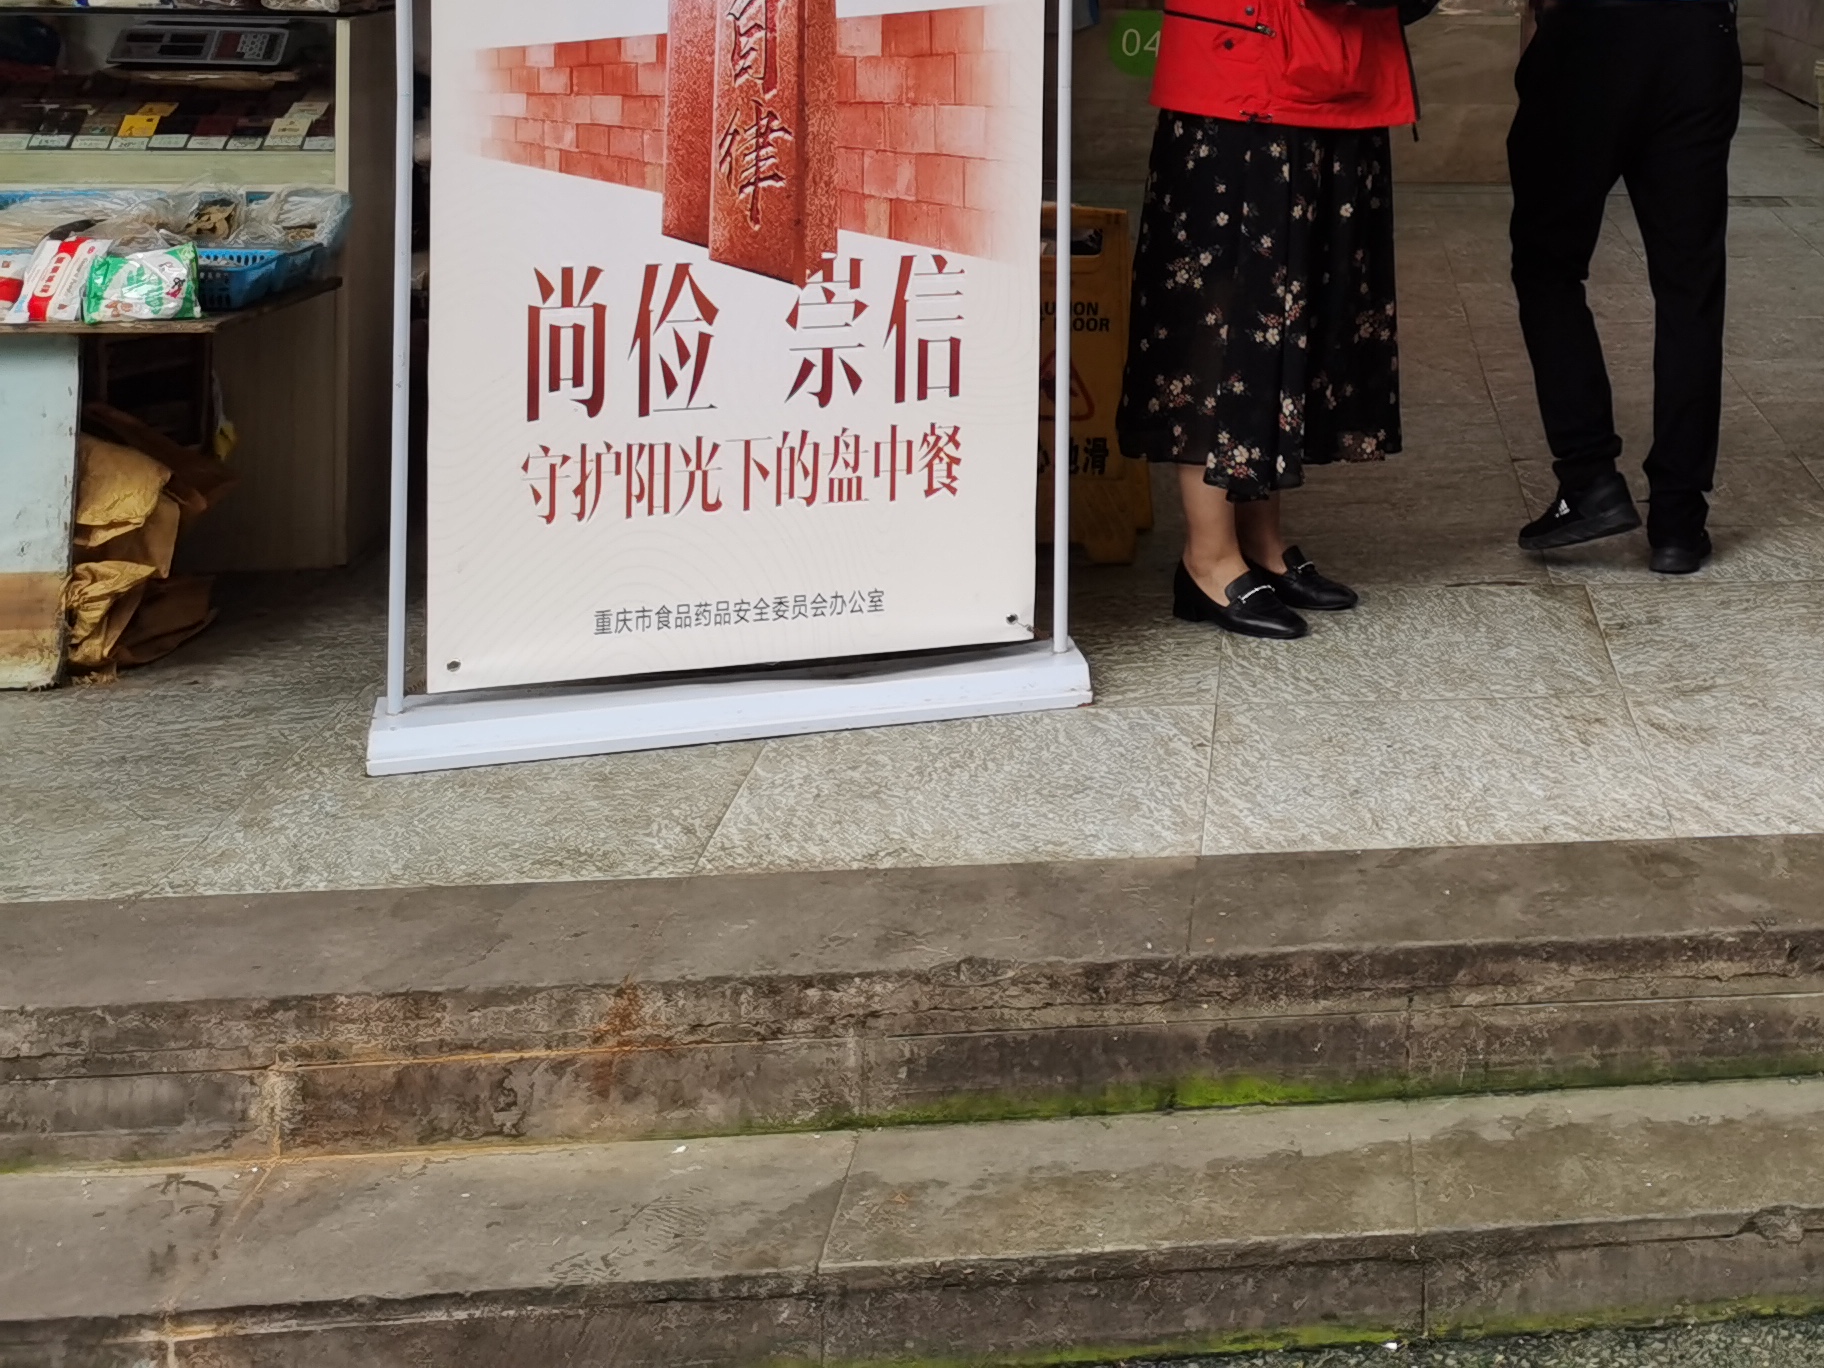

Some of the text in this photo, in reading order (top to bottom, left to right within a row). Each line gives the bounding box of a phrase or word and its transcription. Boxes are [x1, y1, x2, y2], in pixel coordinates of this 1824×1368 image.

[1121, 28, 1161, 58] 04
[526, 253, 966, 422] 尚俭 崇信
[520, 421, 963, 525] 守护阳光下的盘中餐
[592, 587, 886, 637] 重庆市食品药品安全委员会办公室
